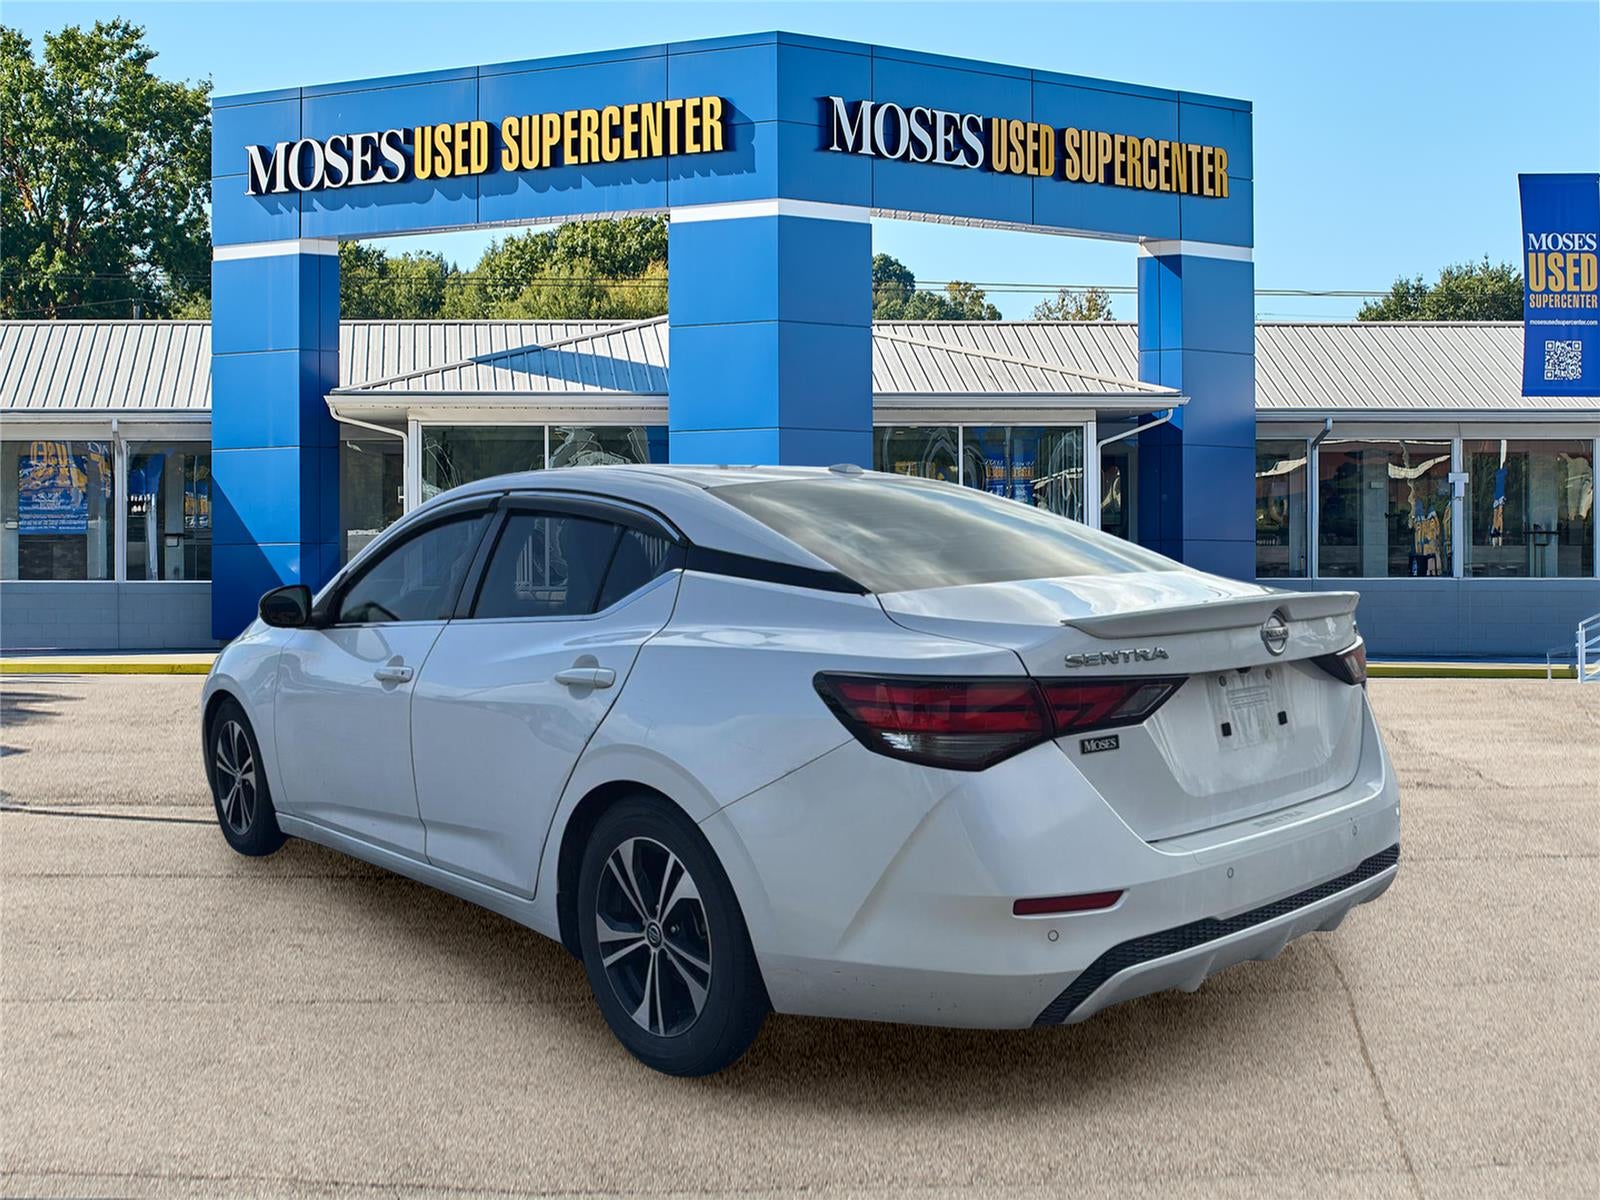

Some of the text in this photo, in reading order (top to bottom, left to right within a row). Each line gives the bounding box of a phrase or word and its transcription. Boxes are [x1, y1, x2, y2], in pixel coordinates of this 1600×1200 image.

[244, 95, 724, 195] MOSES USED SUPERCENTER
[829, 96, 1230, 198] MOSES USED SUPERCENTER
[1527, 233, 1597, 251] MOSES
[1528, 252, 1598, 292] USED
[1529, 294, 1598, 309] SUPERCENTER
[1065, 647, 1169, 668] SENTRA
[1084, 738, 1117, 752] MOSES
